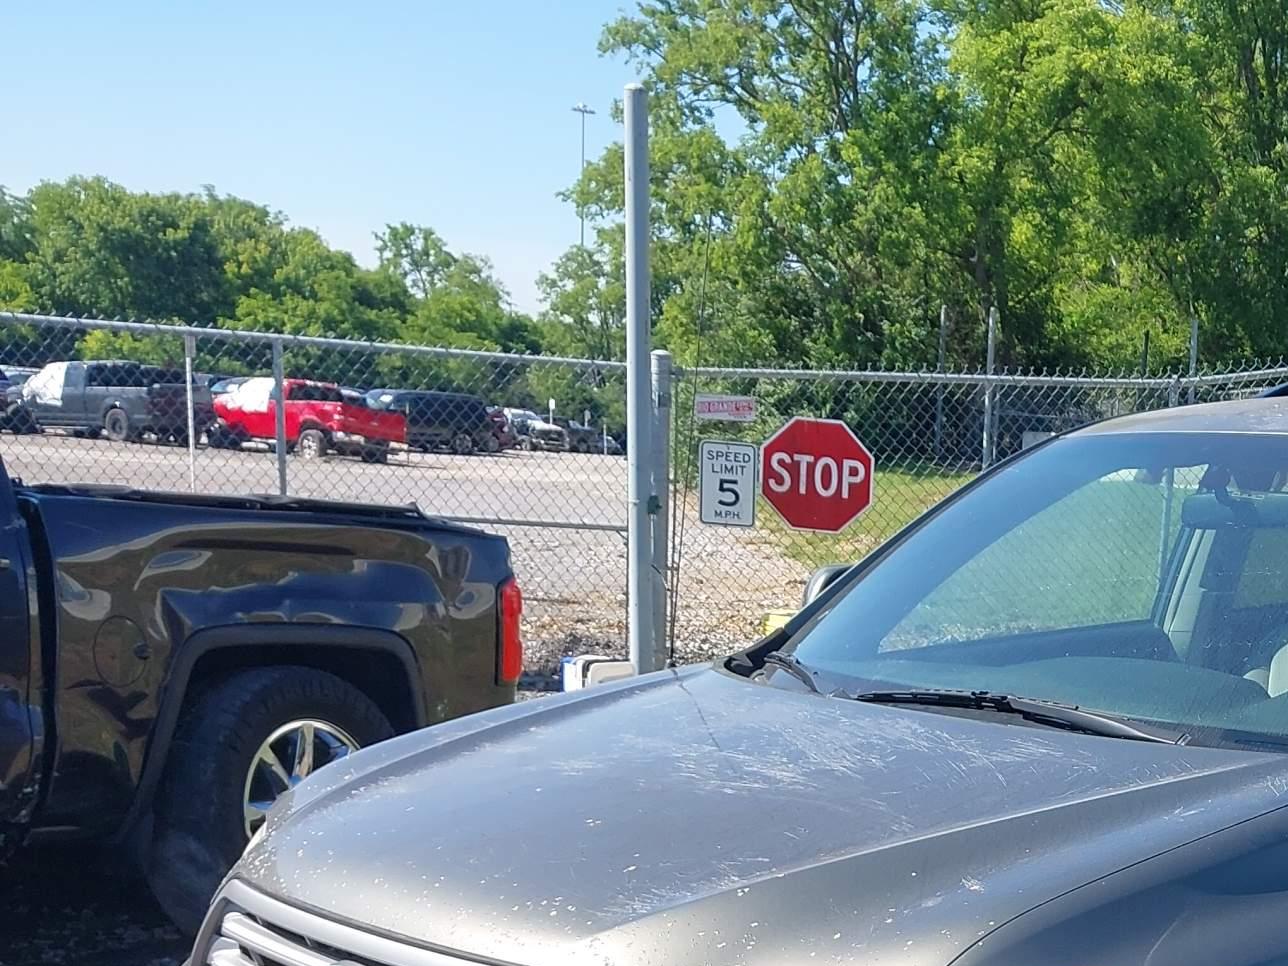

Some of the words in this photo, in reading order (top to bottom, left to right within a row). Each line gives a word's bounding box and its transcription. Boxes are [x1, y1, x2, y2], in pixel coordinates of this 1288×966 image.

[707, 450, 751, 464] SPEED
[711, 463, 747, 476] LIMIT
[768, 452, 866, 499] STOP
[718, 478, 740, 507] 5
